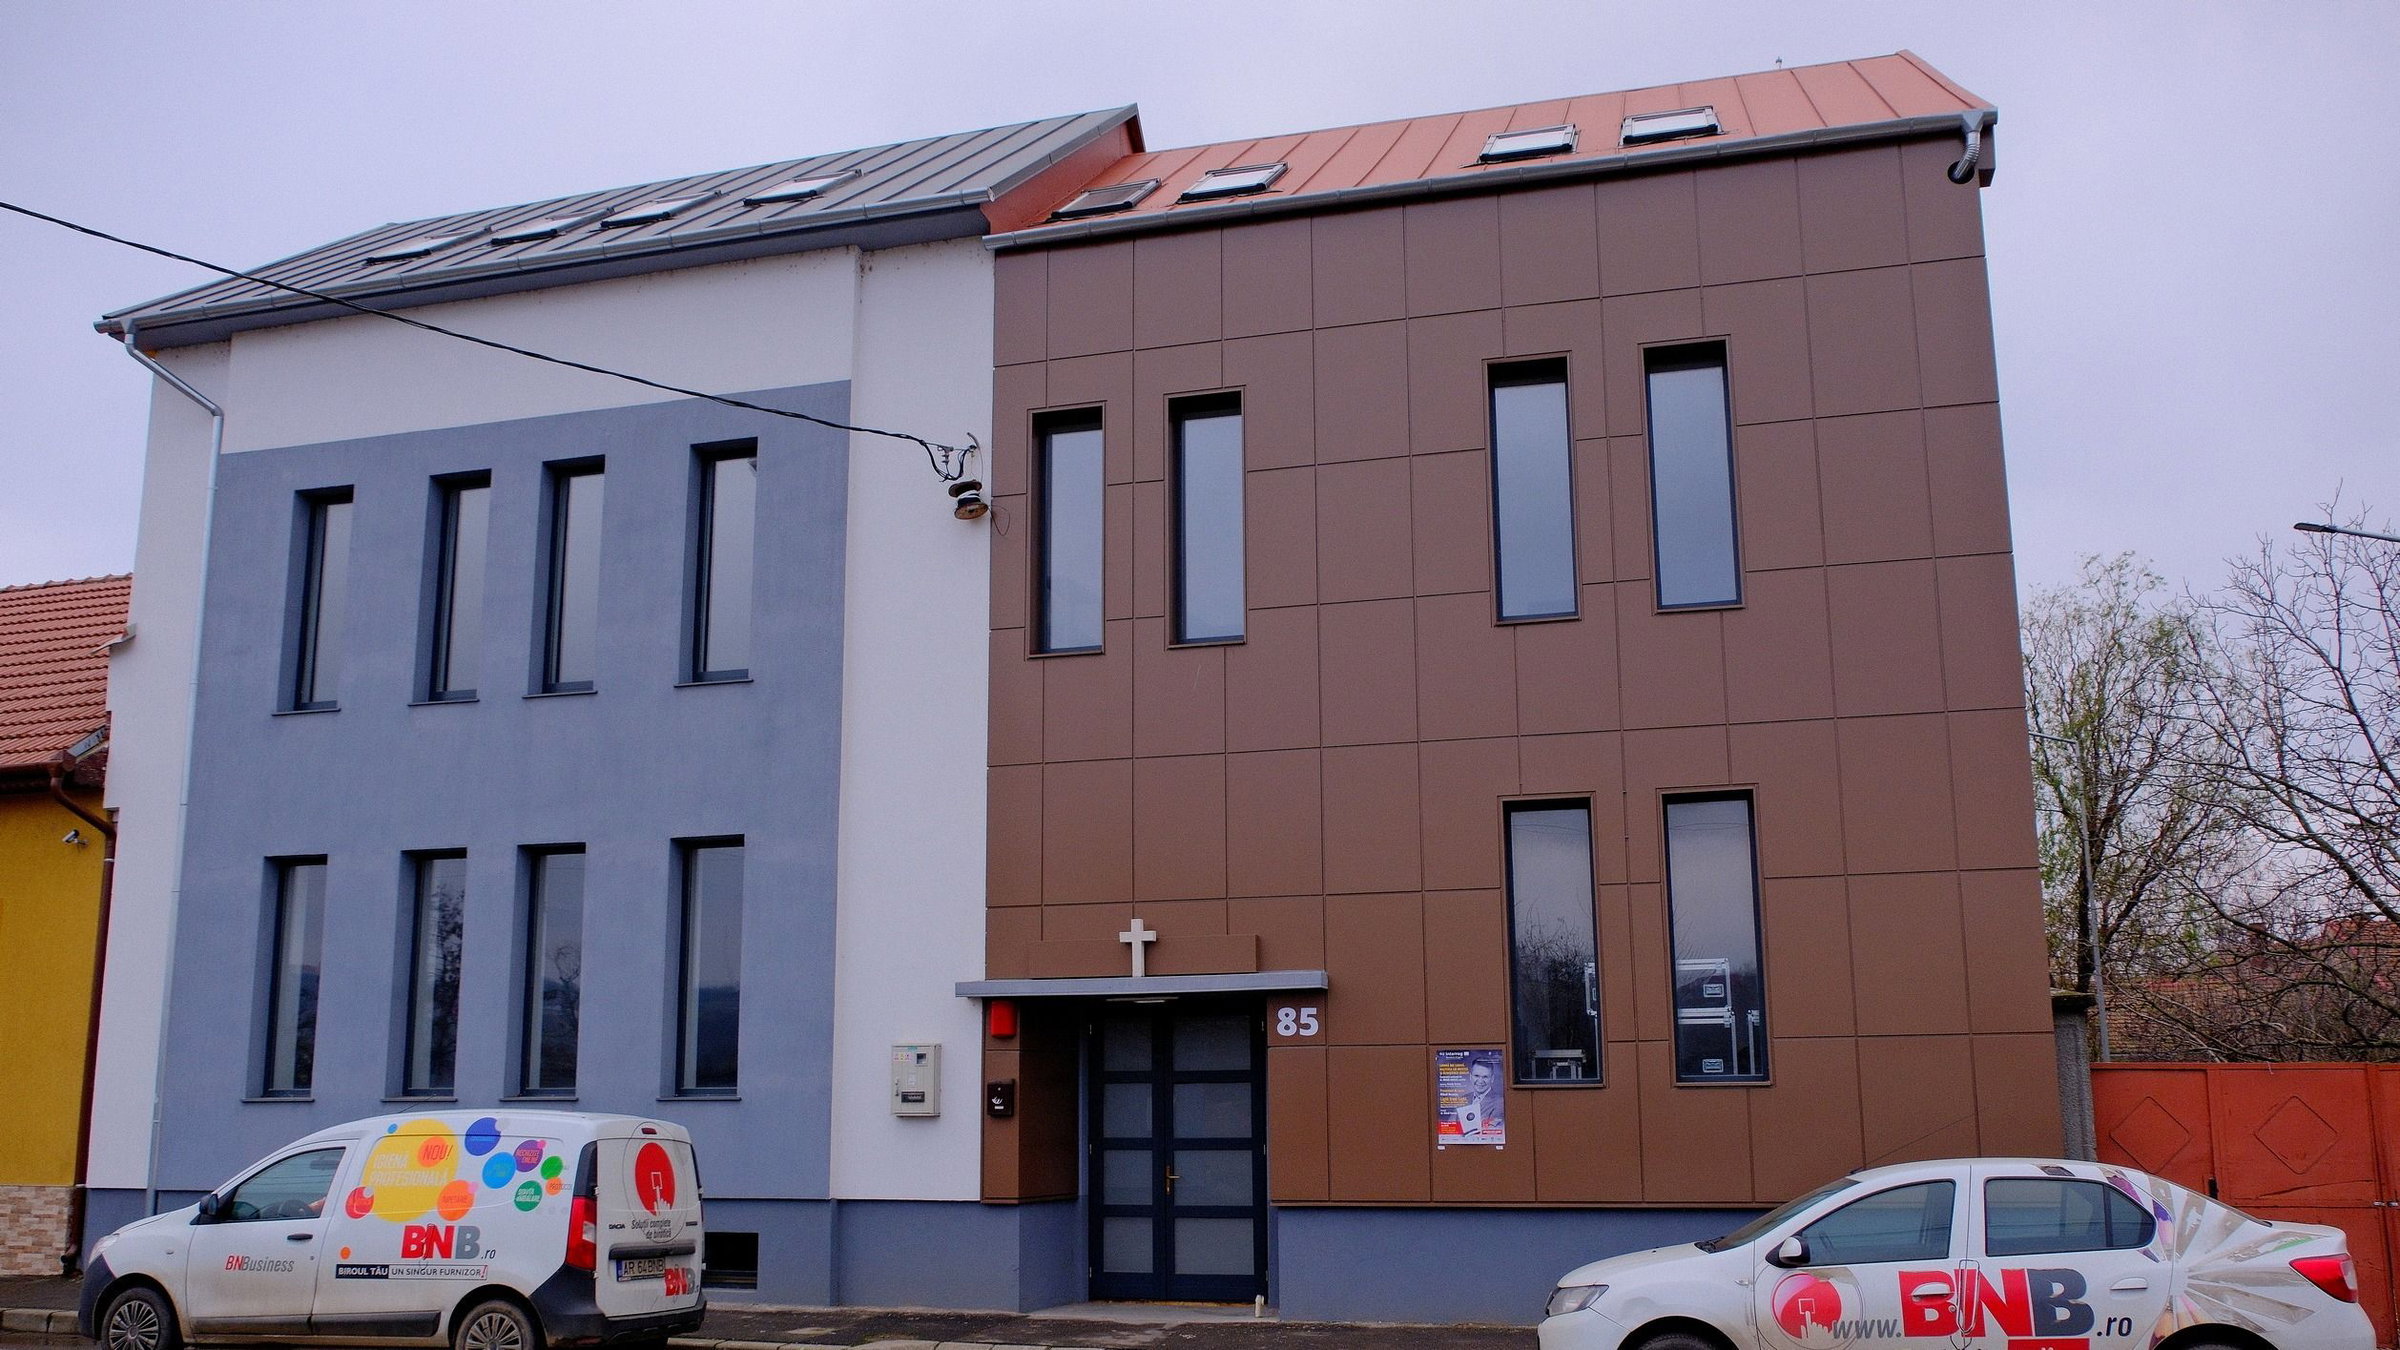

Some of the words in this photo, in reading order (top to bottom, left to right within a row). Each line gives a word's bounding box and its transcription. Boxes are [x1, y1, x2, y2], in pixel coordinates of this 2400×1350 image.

[1277, 1007, 1319, 1037] 85
[421, 1144, 454, 1161] NOU!
[225, 1255, 295, 1273] BNBusiness
[338, 1267, 369, 1276] BIROUL
[391, 1268, 404, 1276] UN
[405, 1268, 438, 1276] SINGUR
